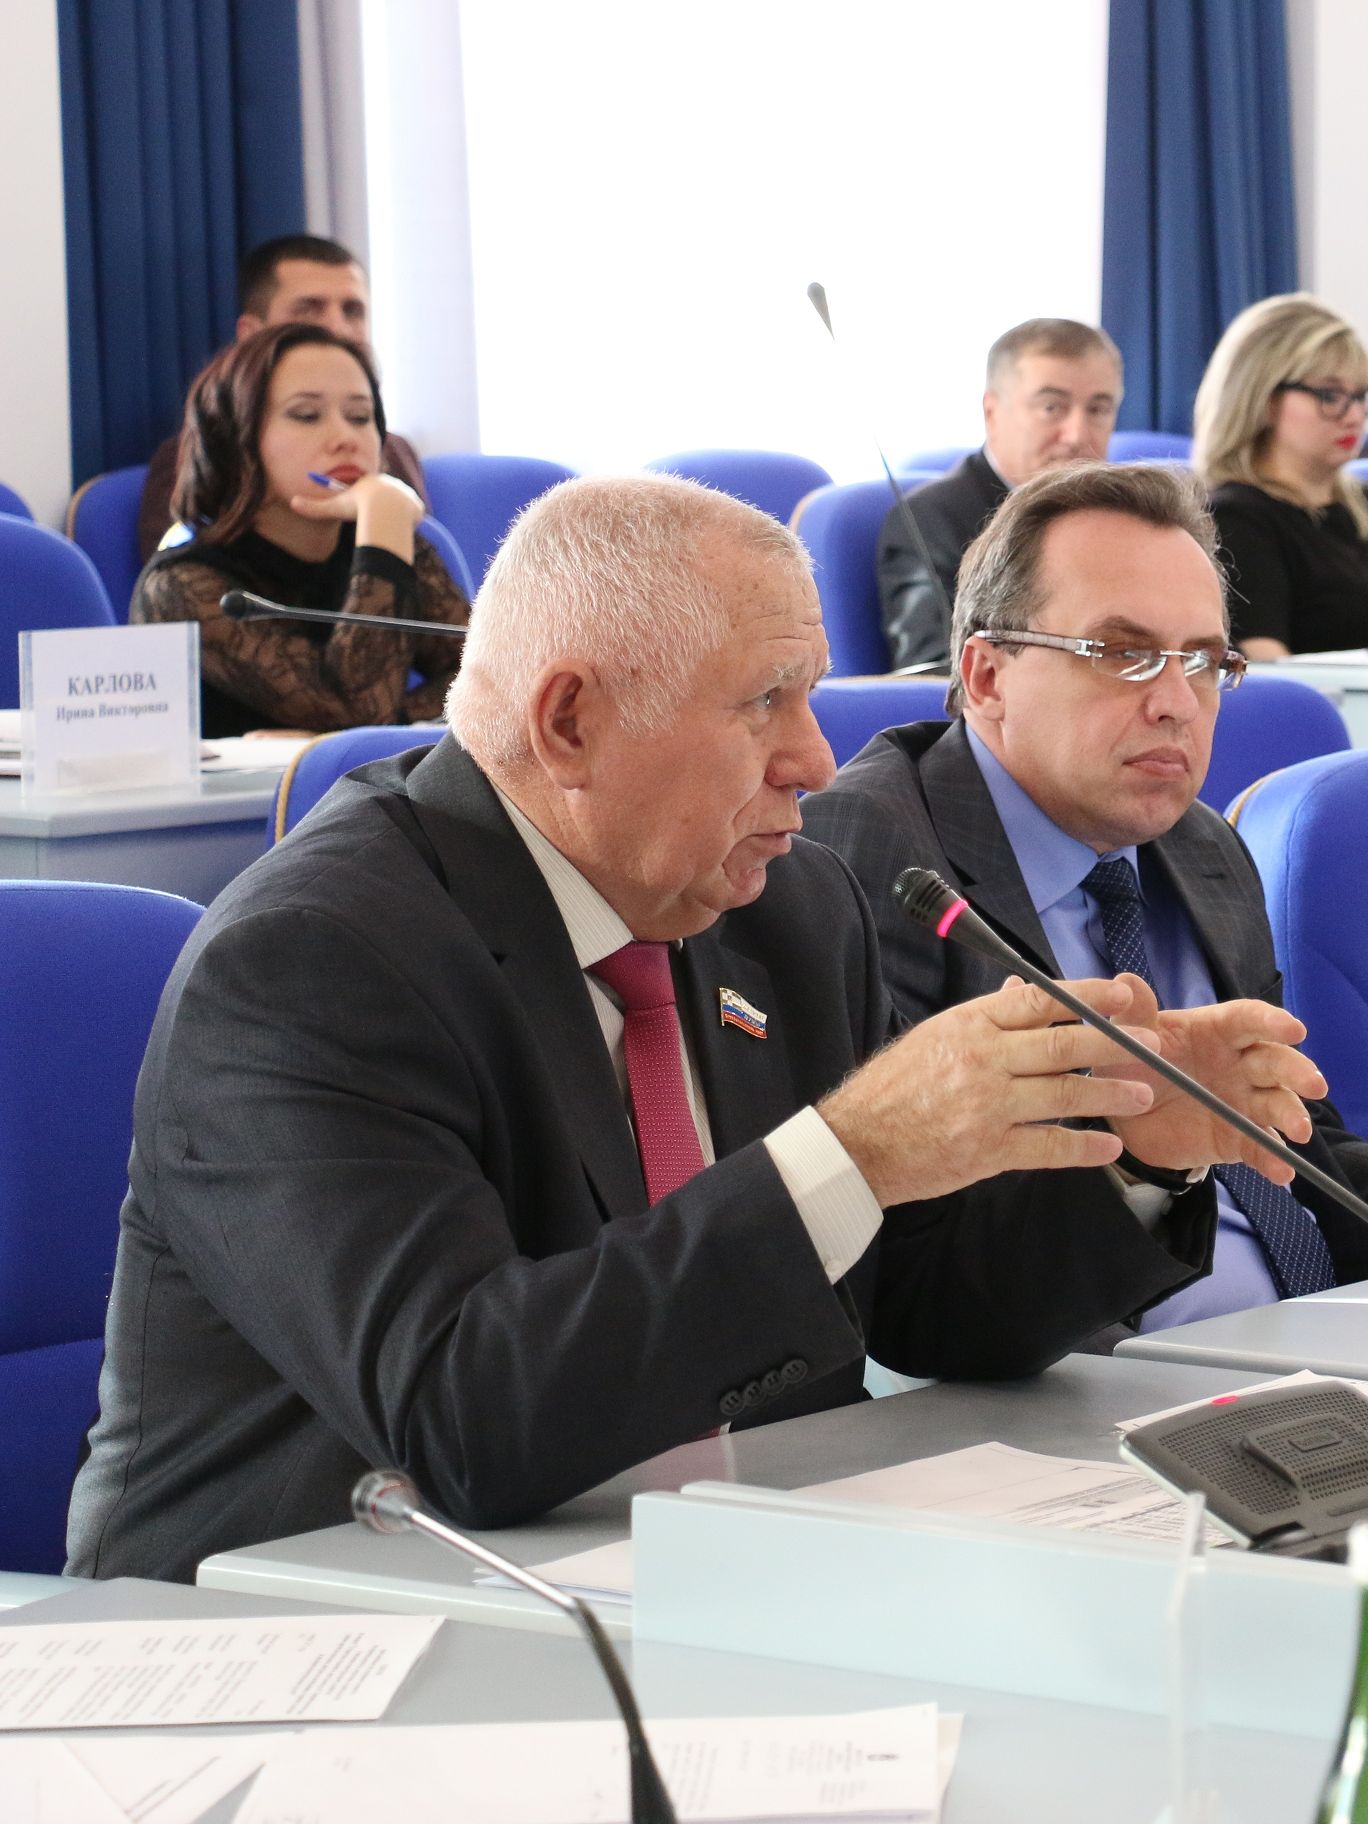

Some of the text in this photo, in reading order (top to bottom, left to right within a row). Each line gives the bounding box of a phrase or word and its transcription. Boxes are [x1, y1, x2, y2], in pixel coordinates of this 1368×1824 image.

[67, 672, 157, 697] КАРЛОВА
[56, 701, 169, 724] Ирина Викторовна
